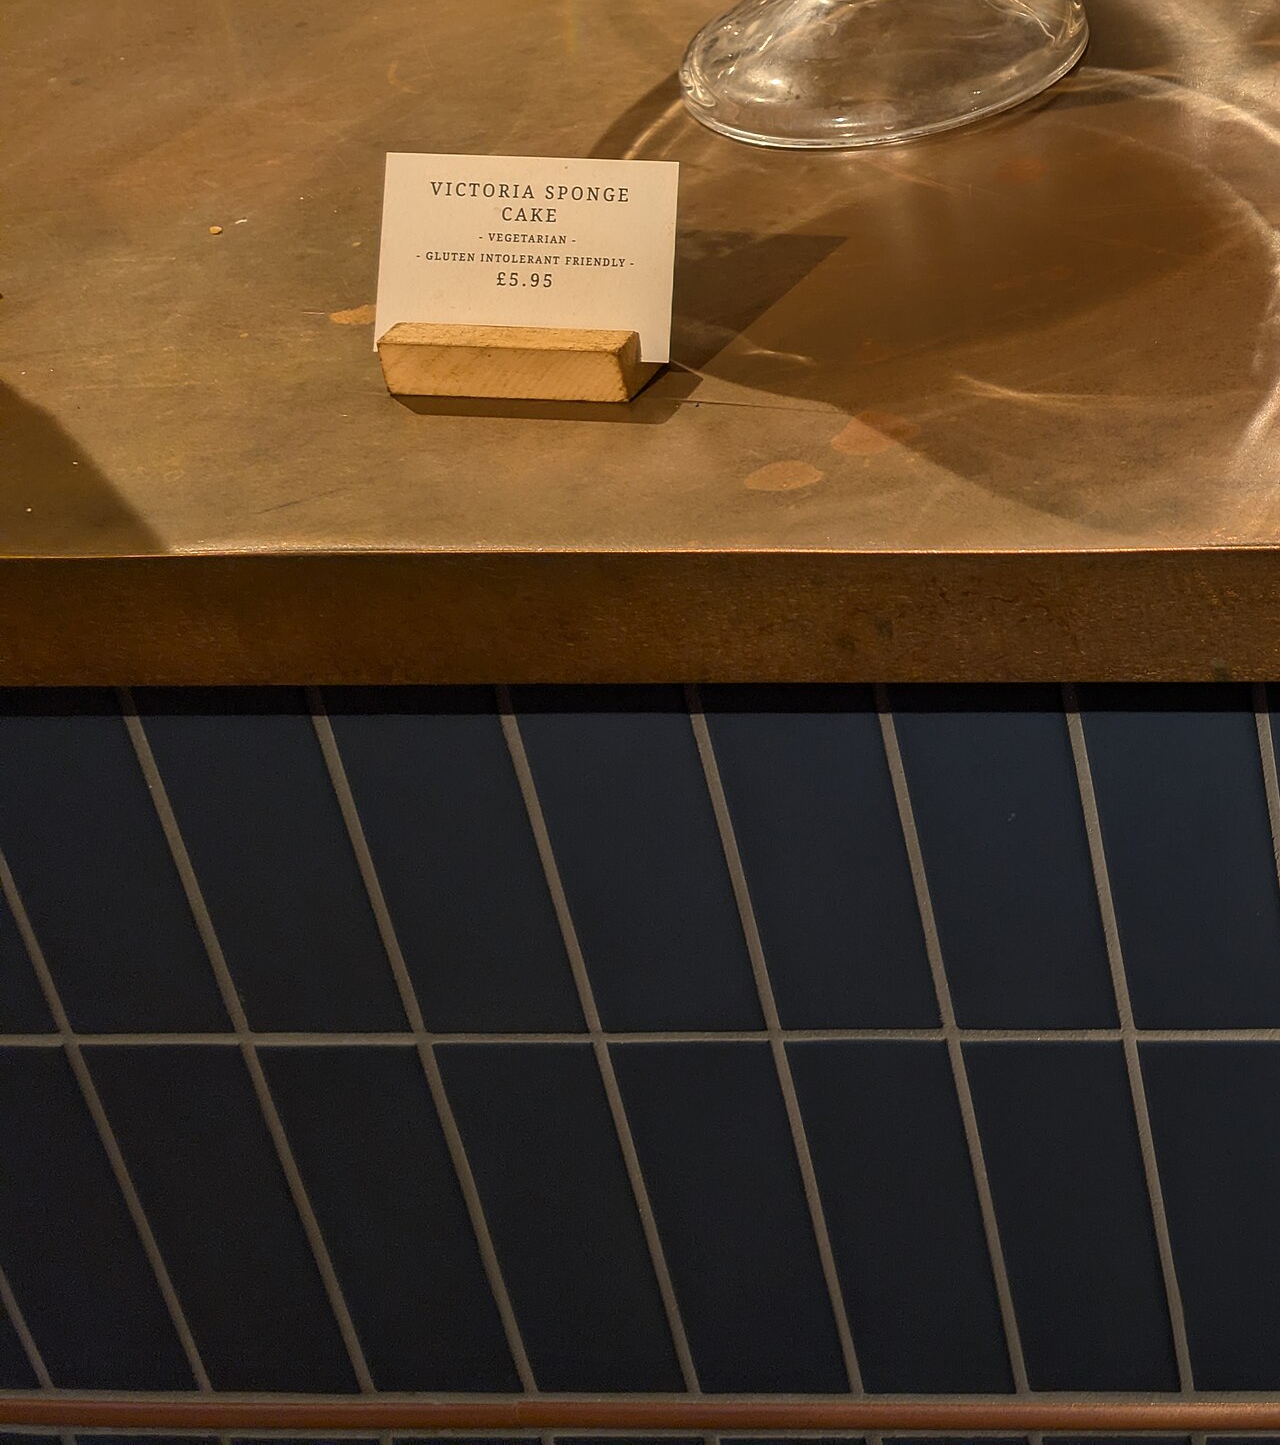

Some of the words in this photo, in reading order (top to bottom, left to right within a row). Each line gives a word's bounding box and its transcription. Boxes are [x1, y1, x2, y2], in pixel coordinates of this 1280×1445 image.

[430, 181, 535, 200] VICTORIA
[545, 185, 630, 202] SPONGE
[501, 206, 557, 223] CAKE
[487, 232, 567, 245] VEGETARIAN
[425, 251, 475, 262] GLUTEN
[480, 253, 560, 265] INTOLERANT
[565, 256, 626, 268] FRIENDLY
[496, 271, 553, 288] £5.95
